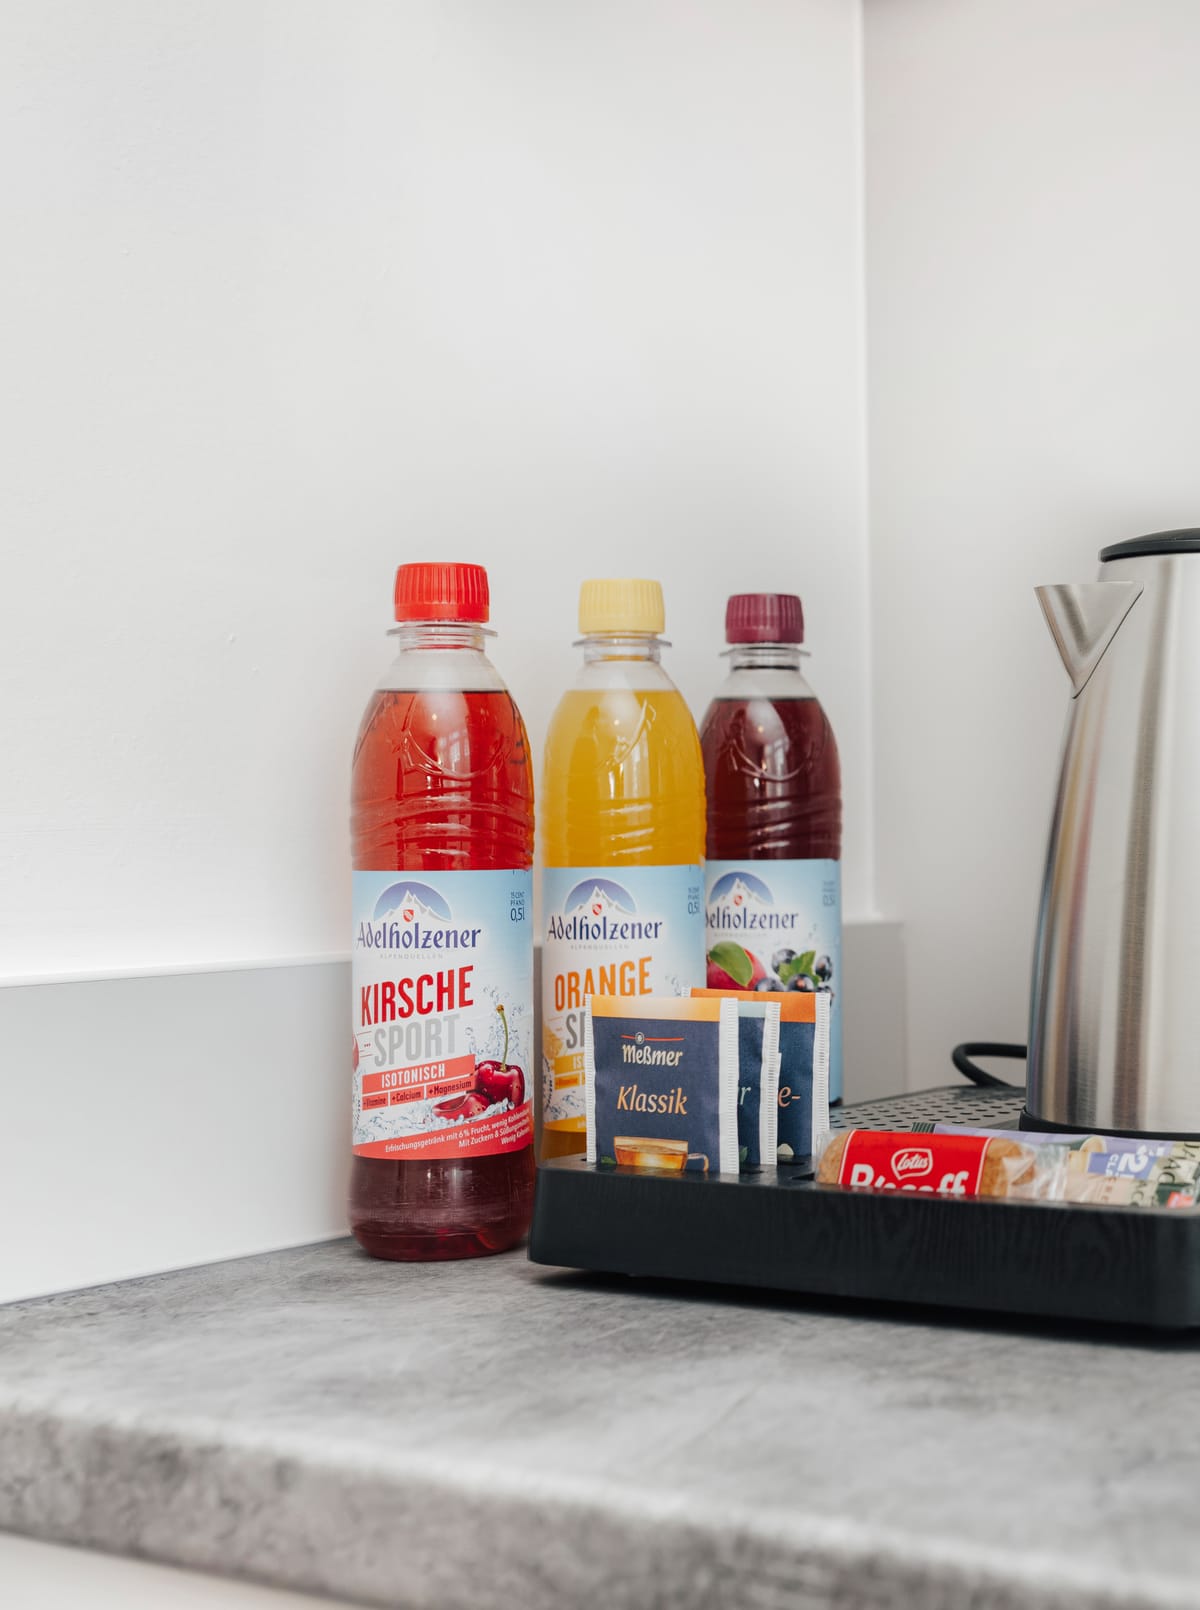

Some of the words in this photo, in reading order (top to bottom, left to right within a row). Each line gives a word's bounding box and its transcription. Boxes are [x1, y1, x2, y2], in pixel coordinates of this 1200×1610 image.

[547, 915, 663, 941] Adelholzener
[706, 906, 799, 929] elholzener
[357, 922, 482, 949] Adelholzener
[361, 965, 474, 1026] KIRSCHE
[555, 956, 653, 1012] ORANGE
[374, 1014, 461, 1067] SPORT
[622, 1043, 684, 1066] Meßmer
[381, 1063, 445, 1088] ISOTONISCH
[616, 1084, 688, 1115] Klassik
[446, 1133, 457, 1142] mit
[471, 1134, 494, 1145] Zuckern
